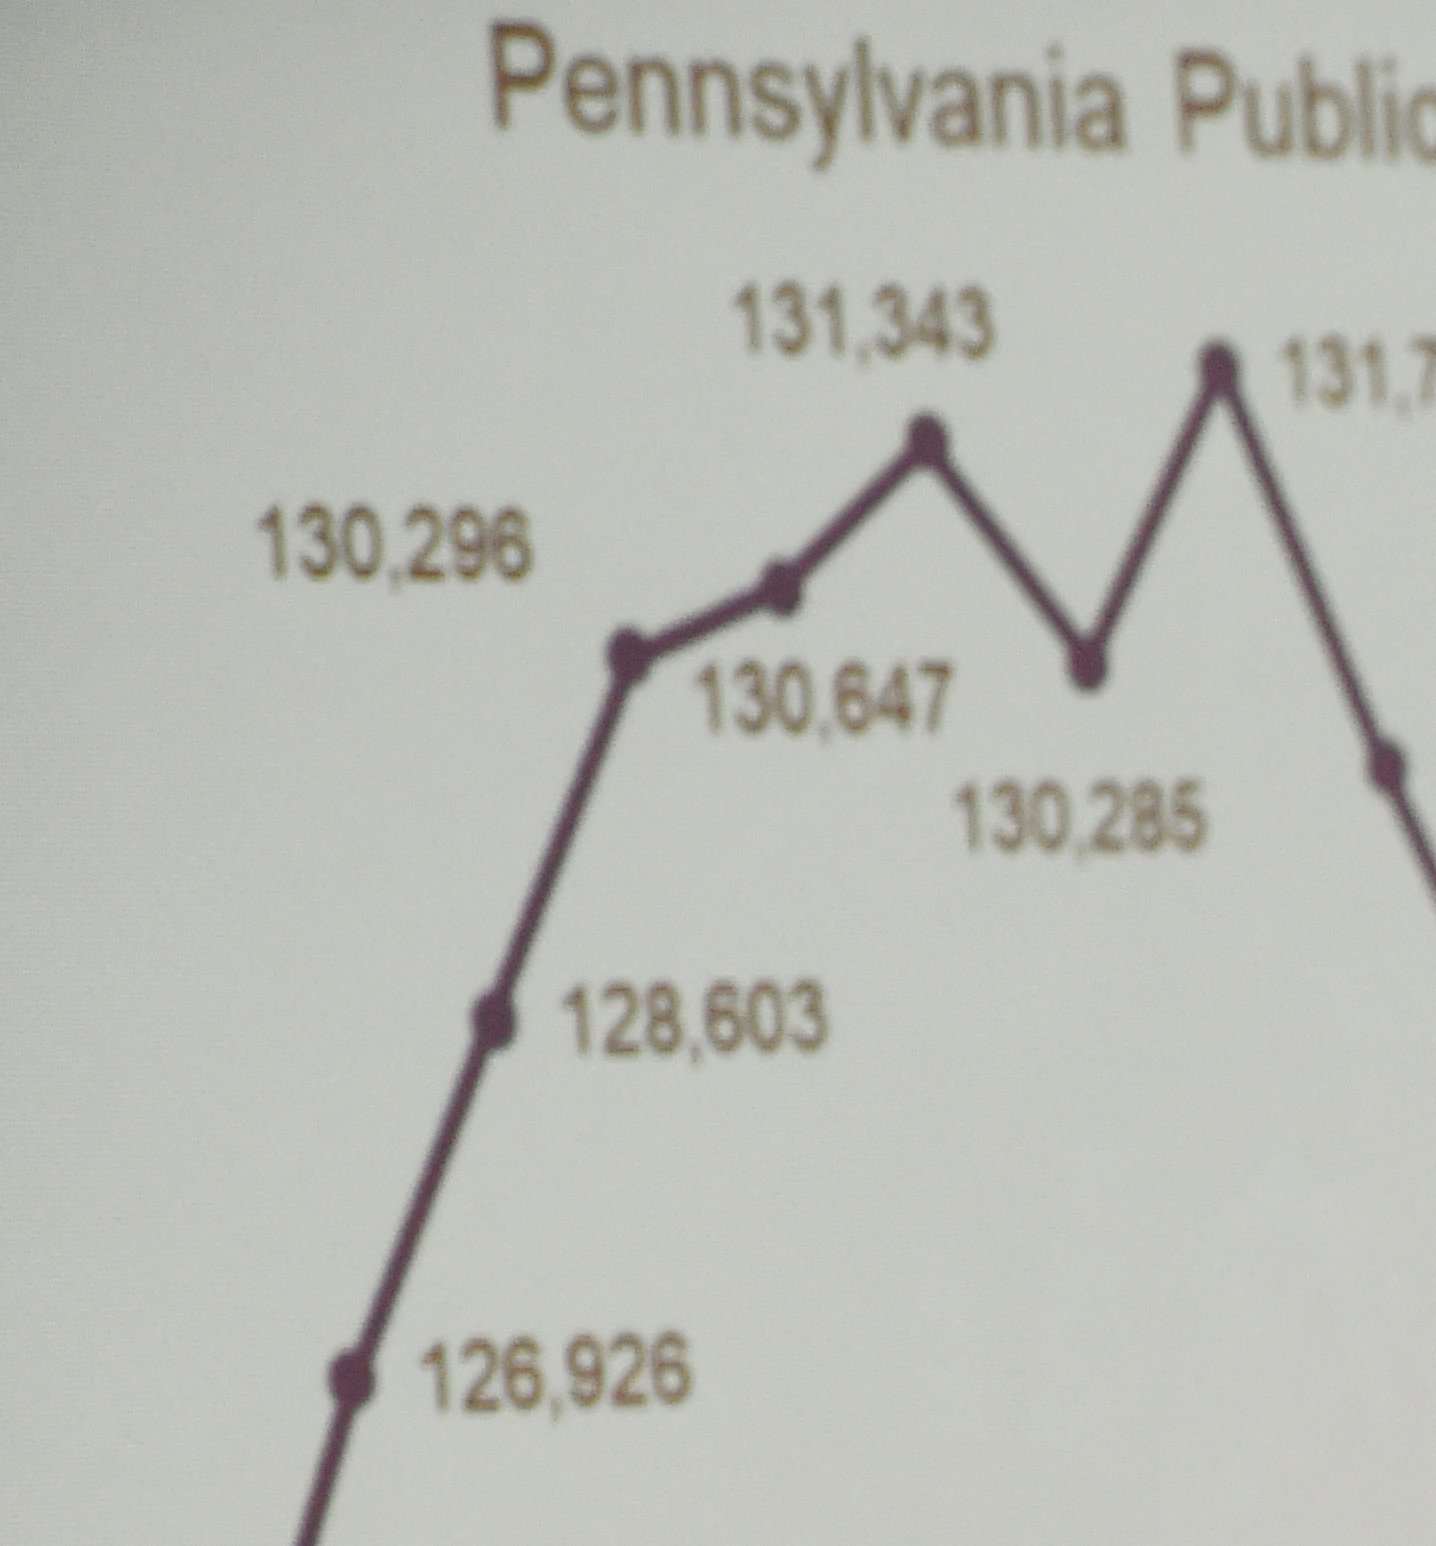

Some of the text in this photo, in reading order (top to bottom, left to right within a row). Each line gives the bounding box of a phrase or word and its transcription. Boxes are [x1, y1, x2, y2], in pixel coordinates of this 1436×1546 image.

[488, 16, 1126, 172] Pennsylvania
[732, 278, 997, 364] 131,343
[256, 500, 535, 587] 130,296
[694, 658, 956, 741] 130,647
[953, 776, 1210, 860] 130,285
[561, 976, 831, 1064] 128,603
[419, 1330, 694, 1419] 126,926
